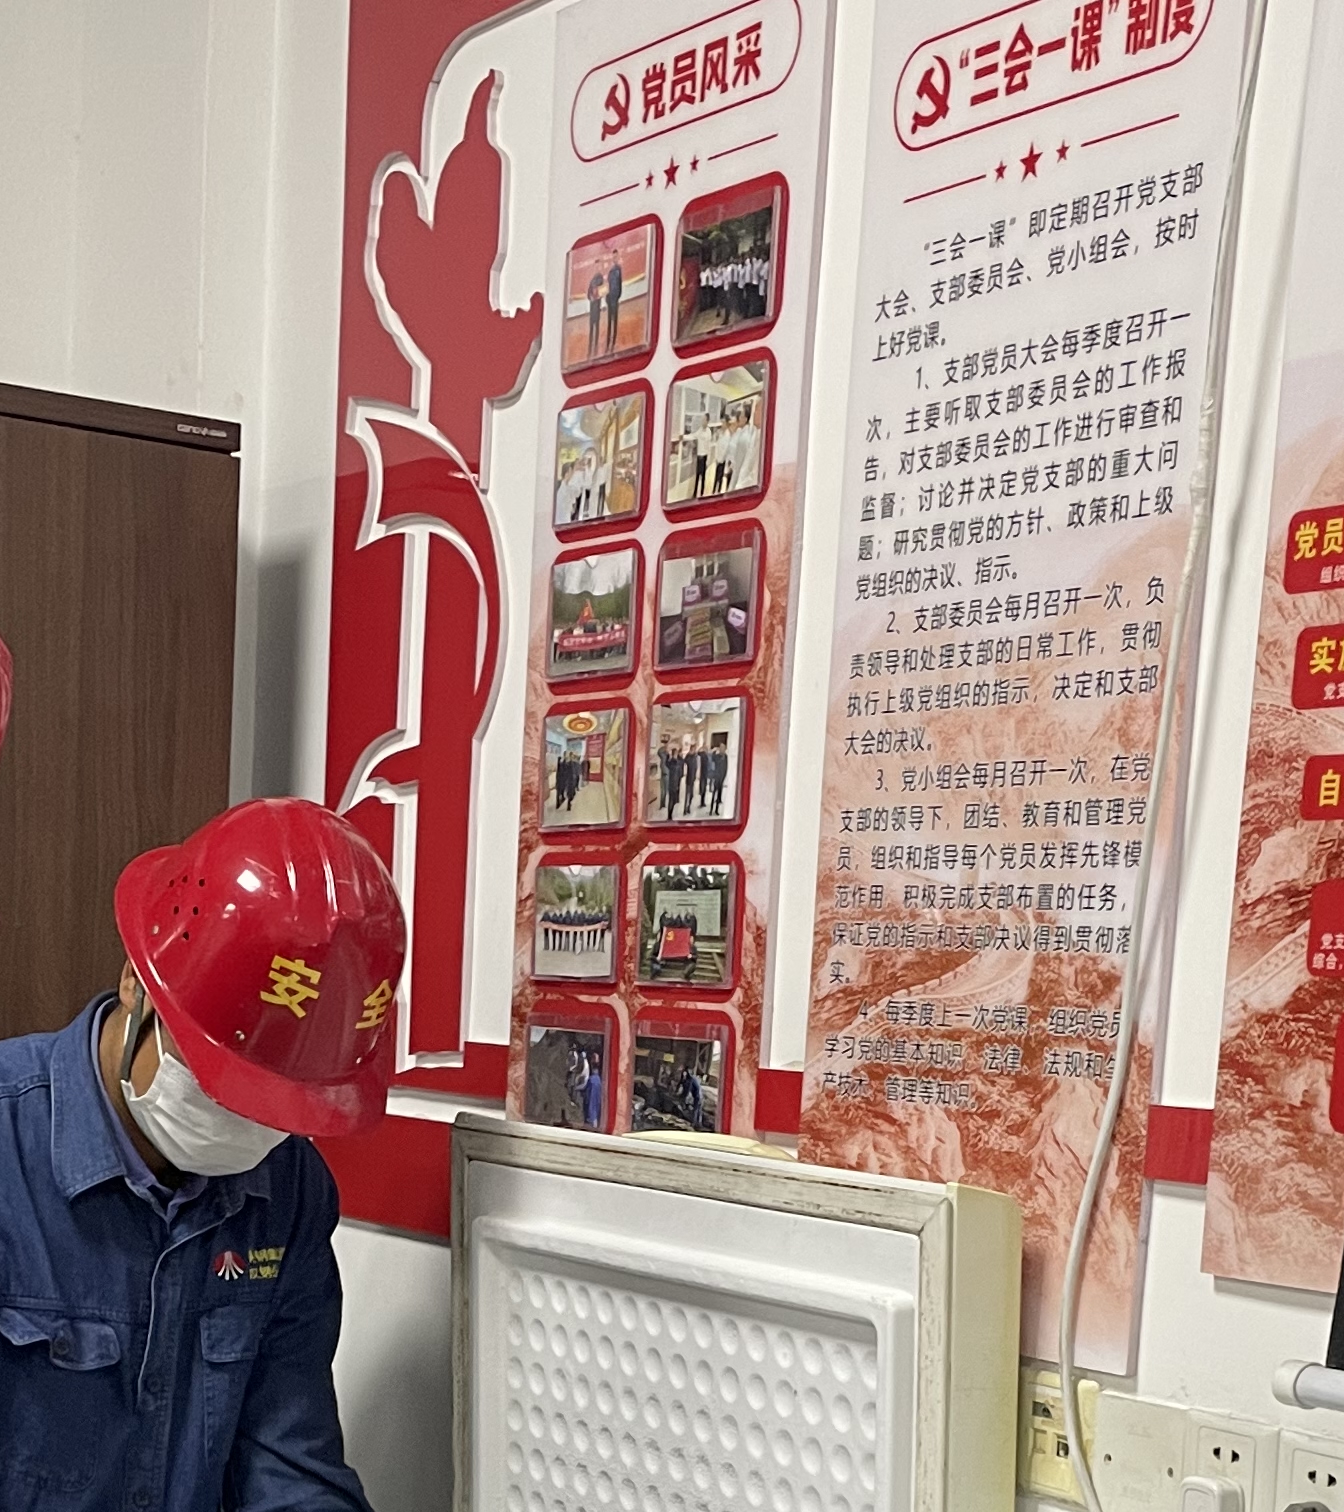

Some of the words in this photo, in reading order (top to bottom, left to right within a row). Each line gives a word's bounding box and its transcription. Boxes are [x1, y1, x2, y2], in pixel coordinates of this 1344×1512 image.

[642, 21, 763, 124] 党员风采
[872, 321, 946, 362] 上好党课。
[915, 308, 1191, 390] 1、支部党员大会每季度召开一
[866, 349, 1186, 442] 次，主要听取支部委员会的工作报
[864, 396, 1182, 482] 告，对支部委员会的工作进行审查和
[855, 554, 1018, 601] 党组织的决议、指示。
[886, 576, 1165, 634] 2、支部委员会每月召开一次，负
[849, 621, 1162, 680] 责领导和处理支部的日常工作，贯彻
[846, 664, 1158, 718] 执行上级党组织的指示，决定和支部
[844, 726, 933, 756] 大会的决议。
[876, 753, 1152, 793] 3、党小组会每月召开一次，在党
[839, 797, 1147, 834] 支部的领导下，团结、教育和管理党
[260, 955, 393, 1030] 安全
[829, 961, 851, 983] 实。
